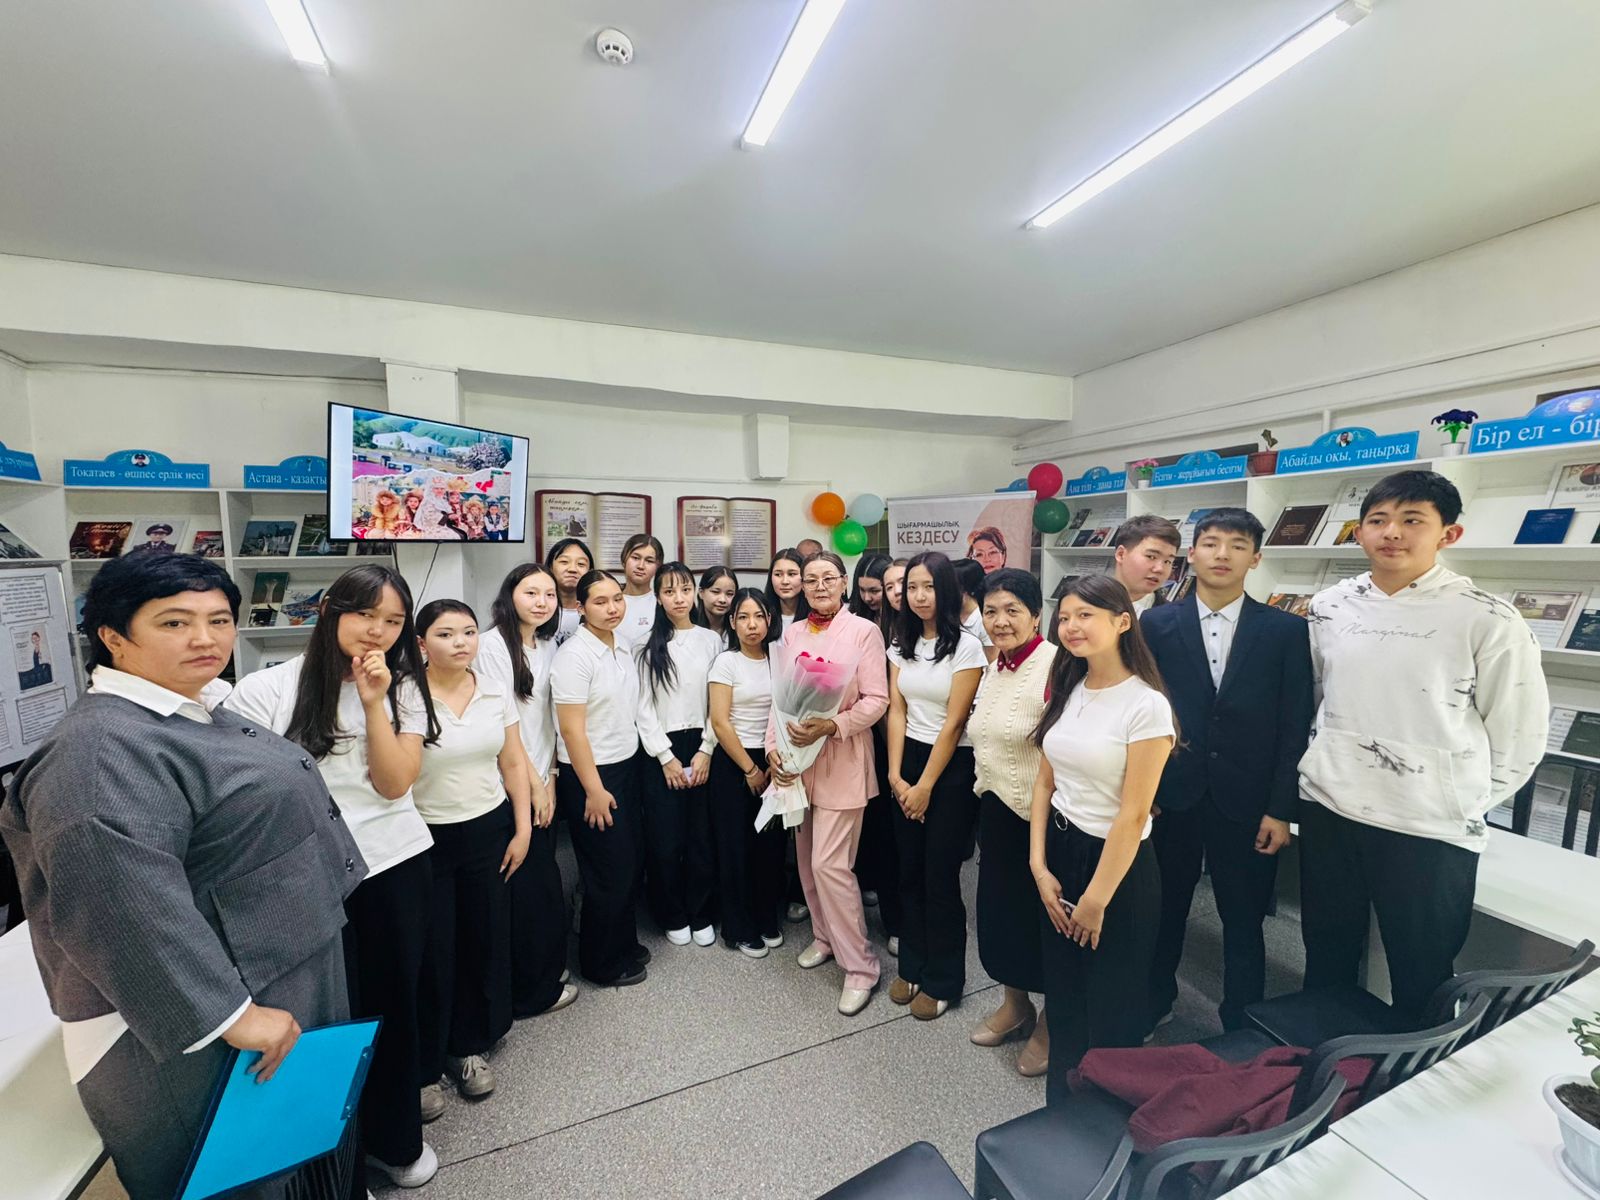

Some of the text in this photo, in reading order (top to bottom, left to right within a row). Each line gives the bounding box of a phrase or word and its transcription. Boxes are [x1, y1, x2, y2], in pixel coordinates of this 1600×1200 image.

[1476, 426, 1511, 449] Бір
[1518, 425, 1545, 441] ел
[1280, 453, 1322, 469] Абайды
[248, 472, 282, 483] Астана
[897, 521, 960, 529] ШЫҒАРМАШЫЛЫҚ
[897, 530, 960, 546] КЕЗДЕСУ
[1339, 622, 1437, 641] Marginal
